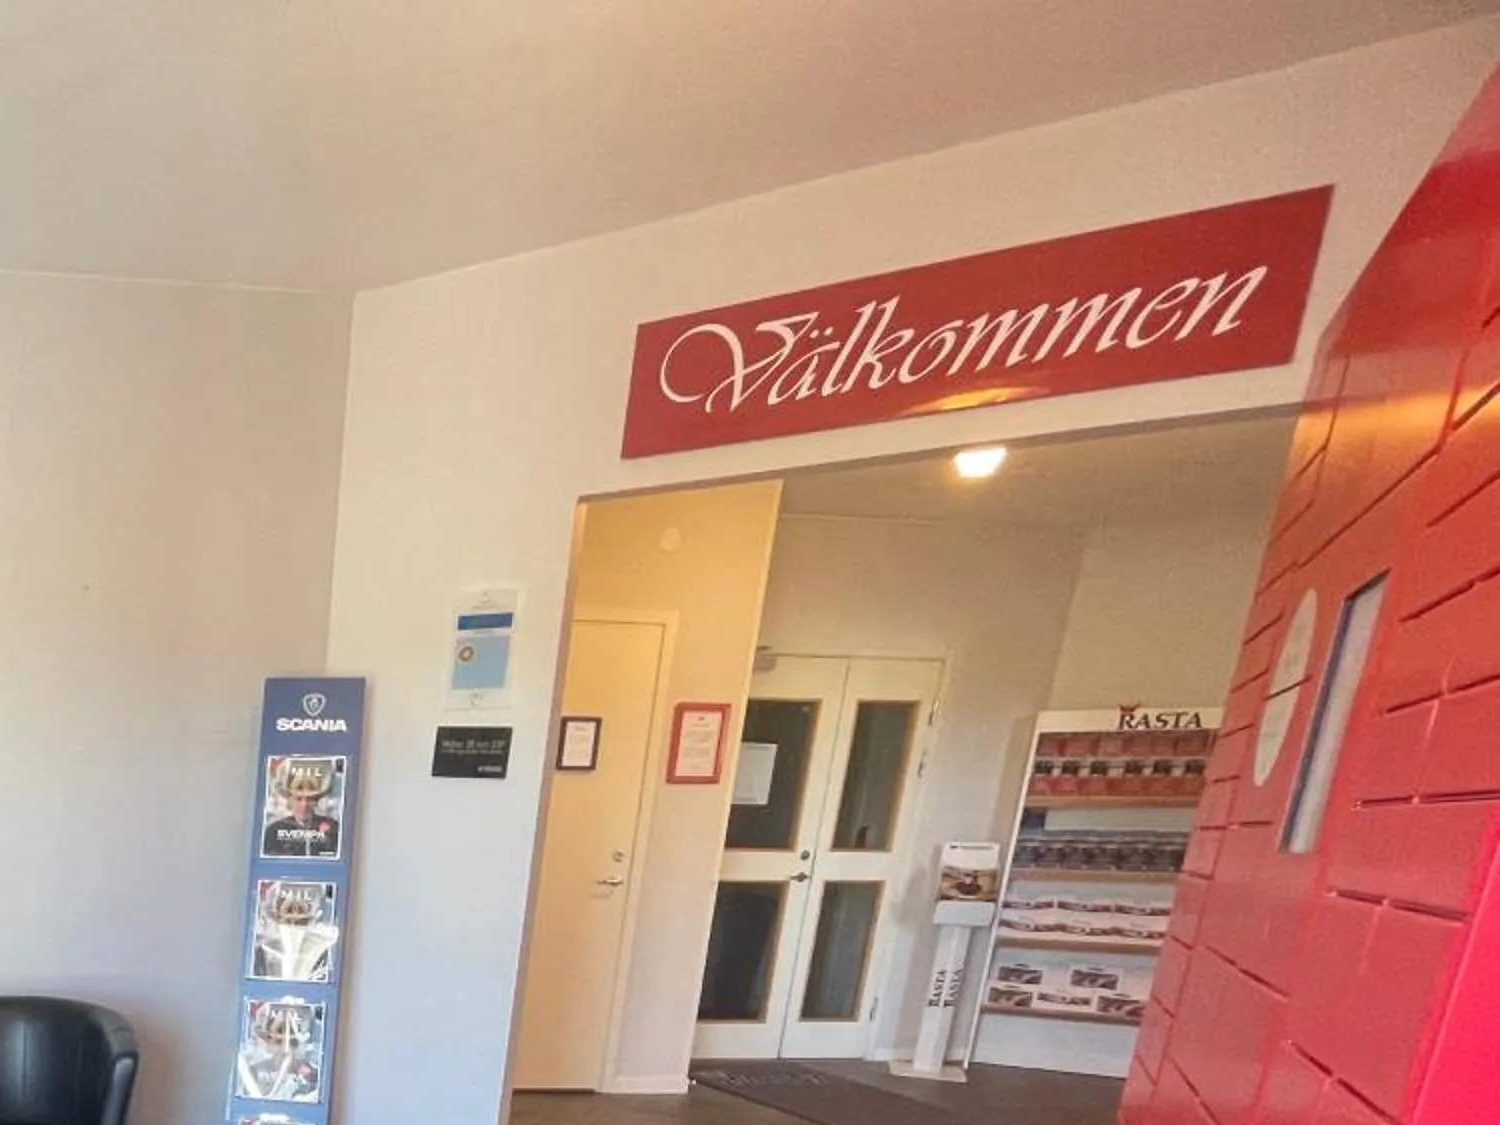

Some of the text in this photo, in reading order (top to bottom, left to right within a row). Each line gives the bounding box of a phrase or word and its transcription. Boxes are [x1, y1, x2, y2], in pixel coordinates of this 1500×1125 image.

[659, 264, 1269, 414] Välkommen
[276, 717, 347, 732] SCANIA
[1117, 711, 1203, 730] RASTA
